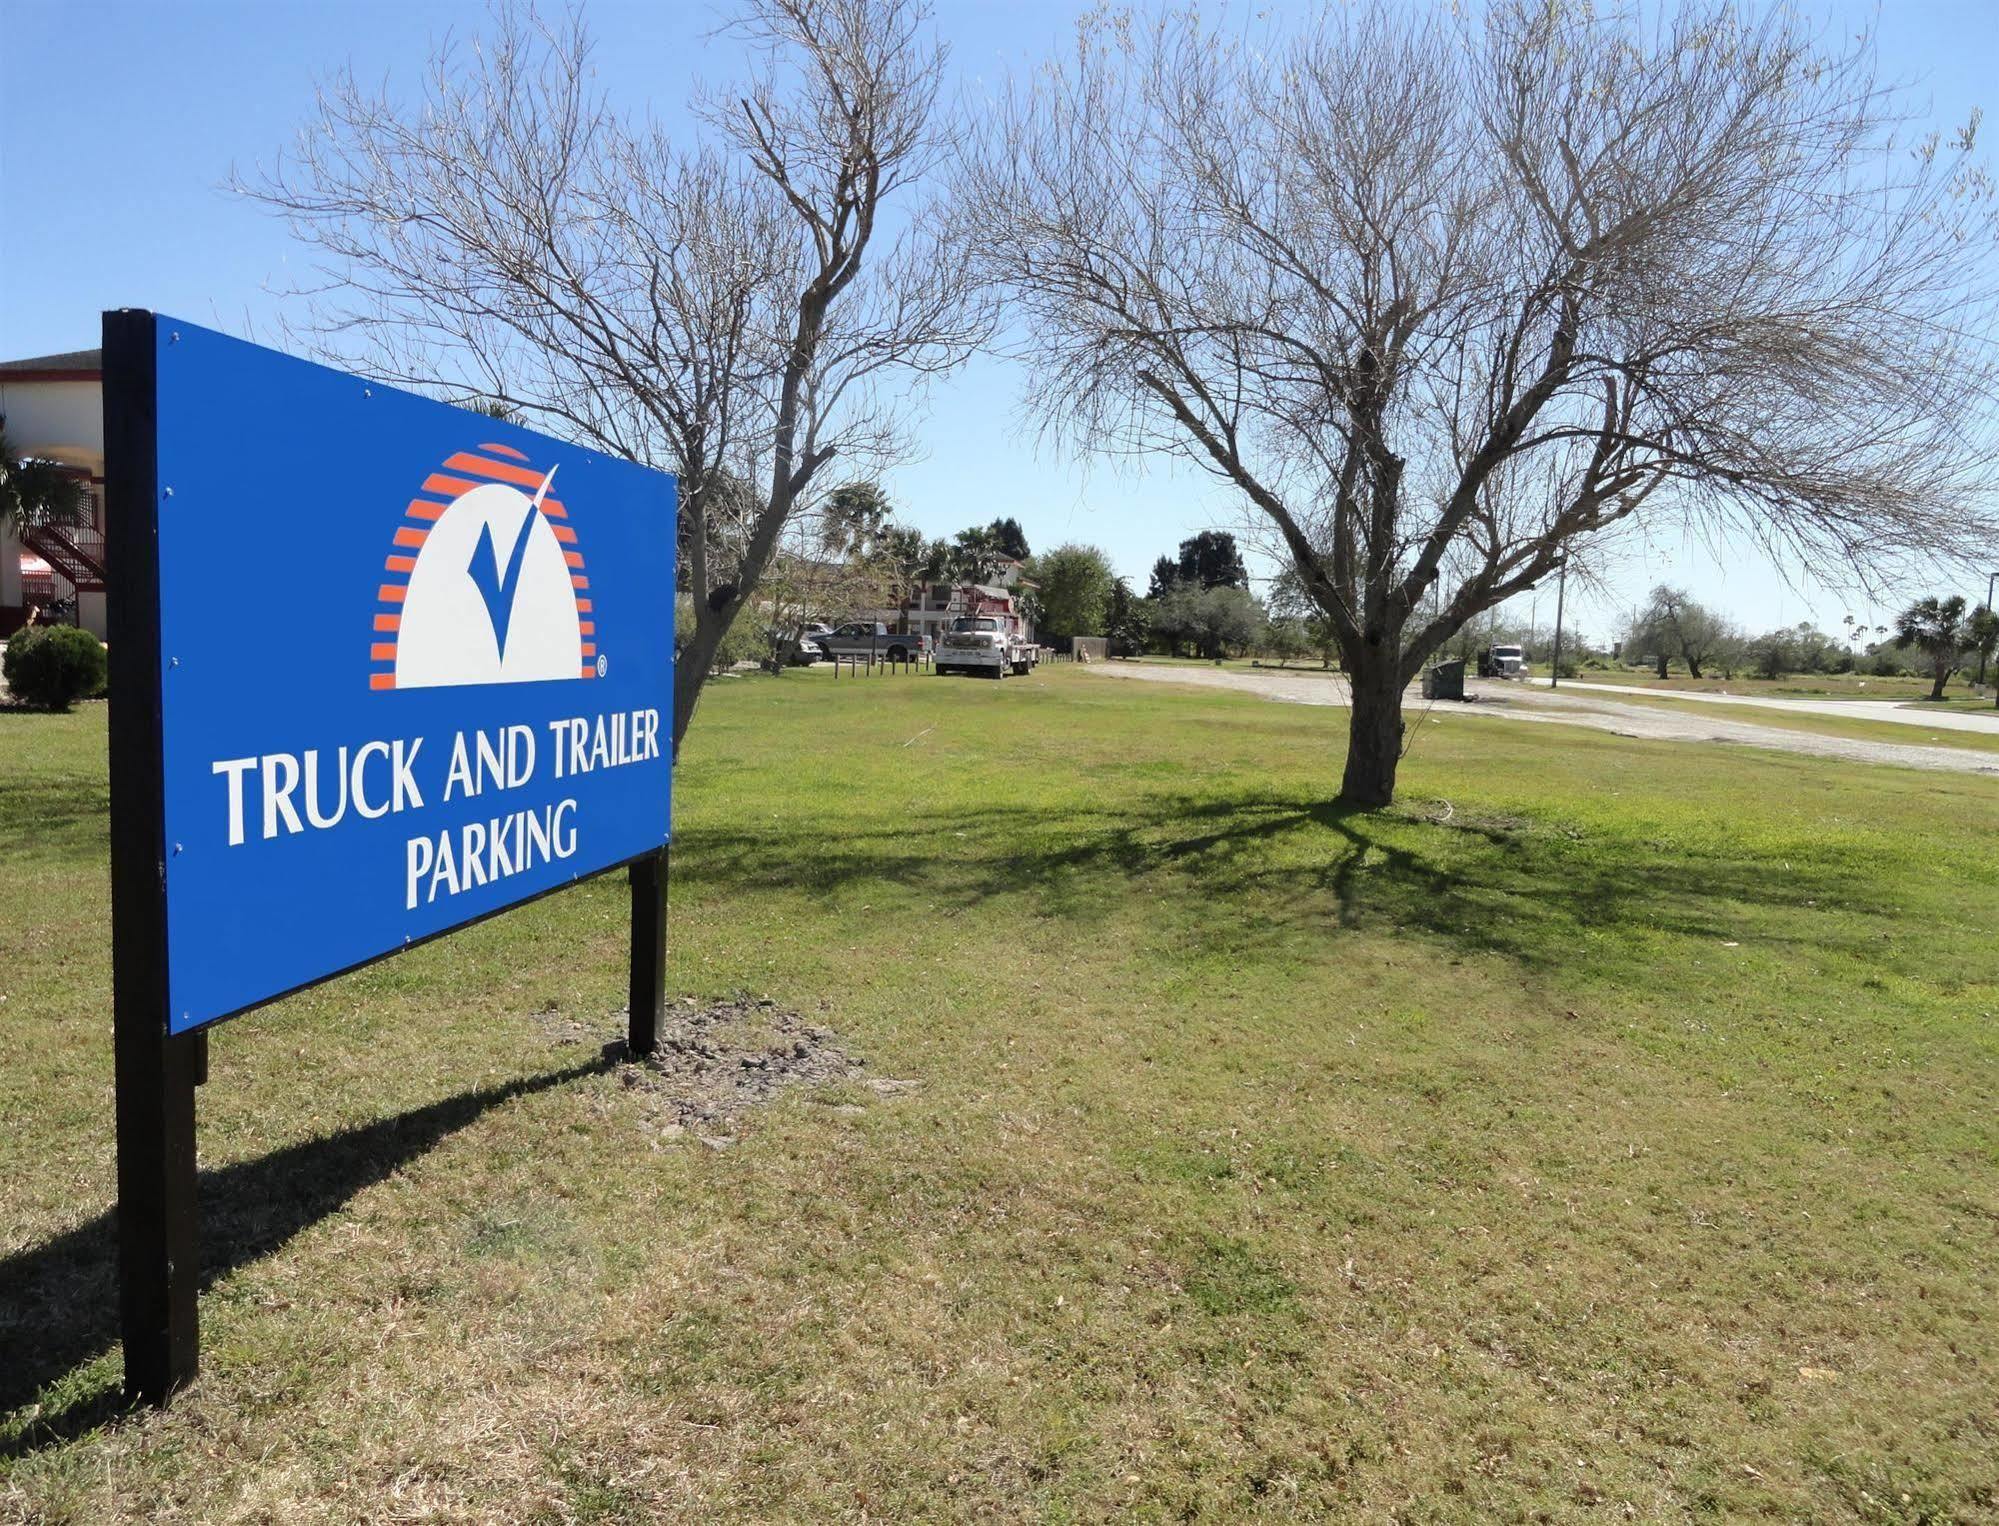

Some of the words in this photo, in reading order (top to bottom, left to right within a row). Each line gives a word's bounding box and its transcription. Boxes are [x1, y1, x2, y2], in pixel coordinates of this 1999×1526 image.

[212, 737, 425, 847] TRUCK
[443, 724, 536, 802] AND
[549, 708, 660, 779] TRAILER
[406, 798, 578, 910] PARKING
